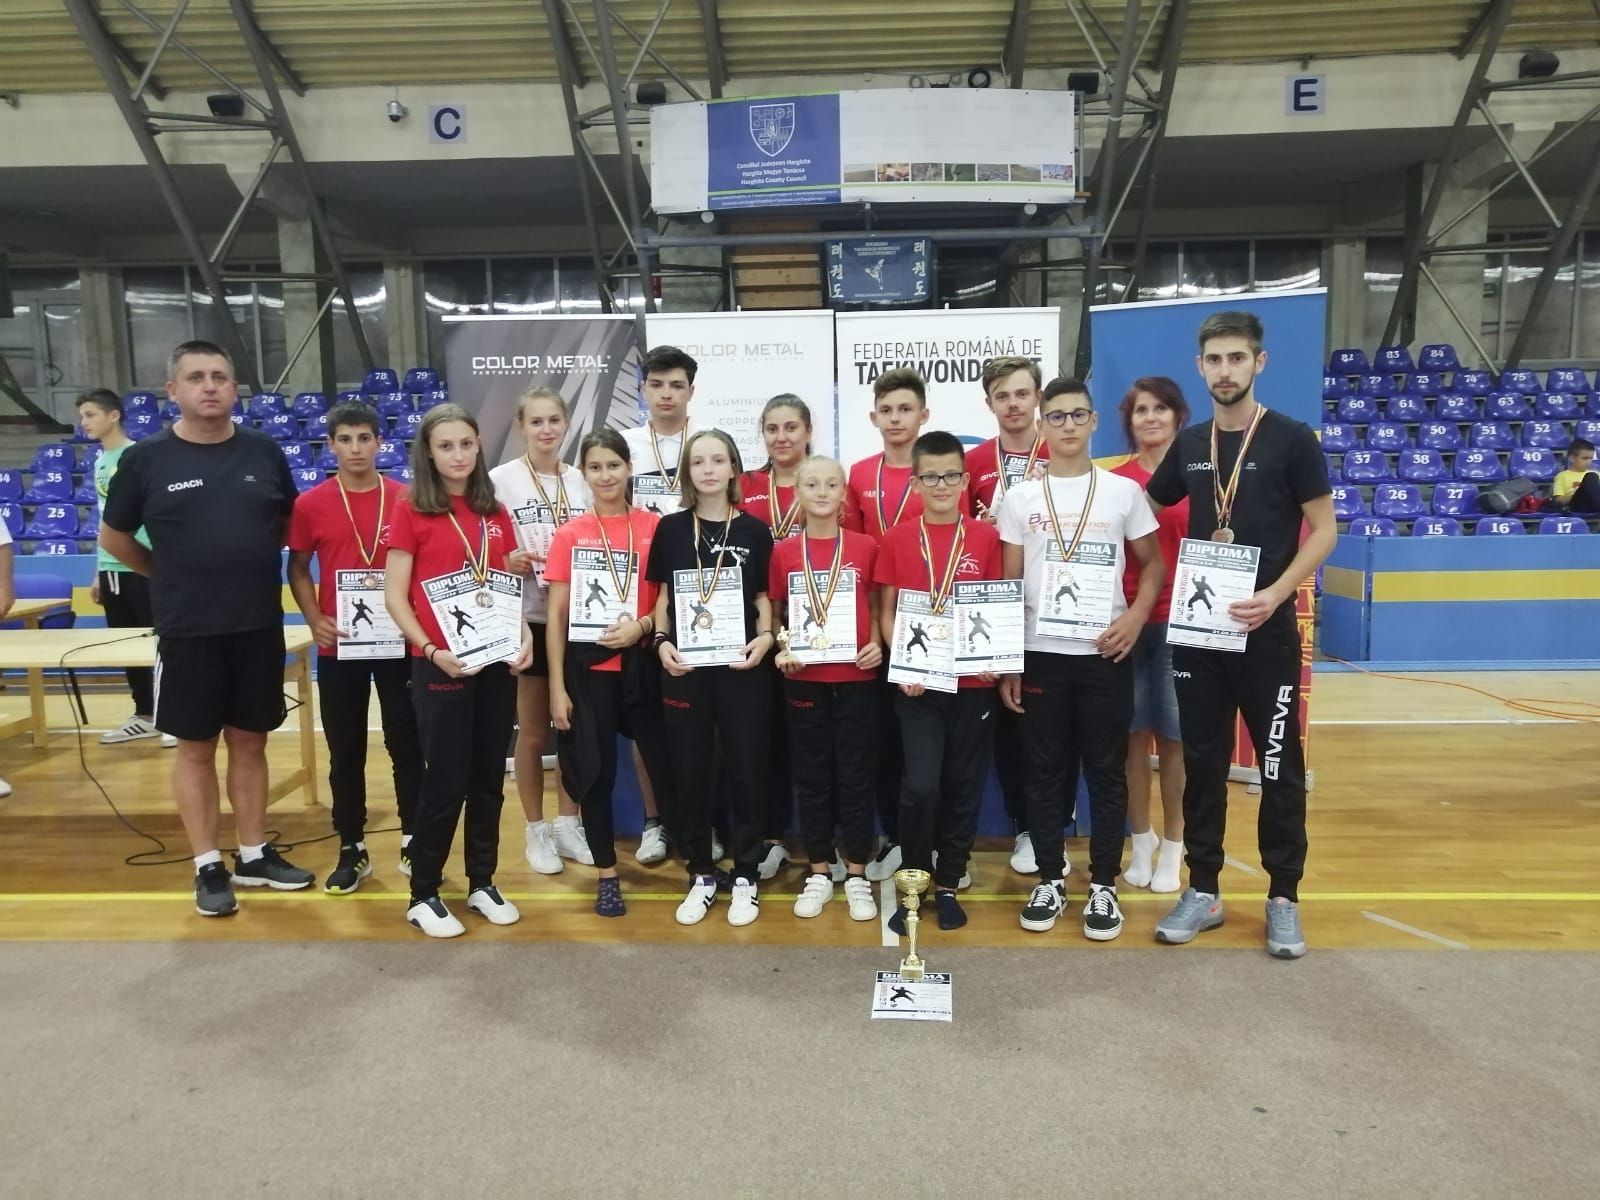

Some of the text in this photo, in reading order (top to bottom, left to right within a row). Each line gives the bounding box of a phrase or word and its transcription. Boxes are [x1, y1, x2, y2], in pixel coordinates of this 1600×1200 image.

[1293, 79, 1318, 111] E
[434, 107, 461, 140] C
[786, 158, 811, 166] Harghita
[744, 342, 804, 356] METAL
[945, 335, 1016, 358] ROMÂNĂ
[1022, 338, 1042, 355] DE
[1386, 350, 1400, 359] 83
[1430, 349, 1444, 358] 84
[472, 356, 540, 370] COLOR
[375, 372, 388, 380] 78
[416, 372, 428, 380] 79
[854, 359, 992, 385] TAWOND
[1511, 372, 1527, 381] 75
[1559, 372, 1574, 380] 76
[133, 396, 147, 405] 67
[303, 395, 318, 404] 71
[708, 398, 768, 407] ALUMINIU
[1349, 400, 1365, 409] 60
[1399, 399, 1415, 408] 61
[1448, 397, 1464, 407] 62
[1498, 396, 1515, 406] 63
[137, 415, 151, 424] 57
[273, 415, 288, 424] 60
[407, 415, 422, 423] 63
[719, 417, 764, 426] COPPE
[1325, 426, 1342, 436] 48
[1378, 428, 1395, 438] 49
[1430, 425, 1447, 435] 50
[1481, 426, 1497, 435] 51
[1534, 424, 1551, 433] 52
[285, 446, 300, 455] 50
[380, 443, 394, 453] 52
[1354, 454, 1371, 464] 37
[1412, 454, 1430, 464] 38
[1523, 451, 1542, 462] 40
[1187, 462, 1214, 472] COACH
[300, 471, 317, 481] 40
[168, 479, 204, 492] COACH
[1388, 489, 1408, 500] 26
[1447, 489, 1464, 499] 27
[47, 507, 66, 519] 25
[1364, 523, 1382, 536] 14
[1427, 523, 1444, 535] 15
[1491, 522, 1510, 534] 16
[1556, 522, 1573, 534] 17
[48, 544, 67, 555] 15
[1264, 685, 1294, 781] GIVOVA
